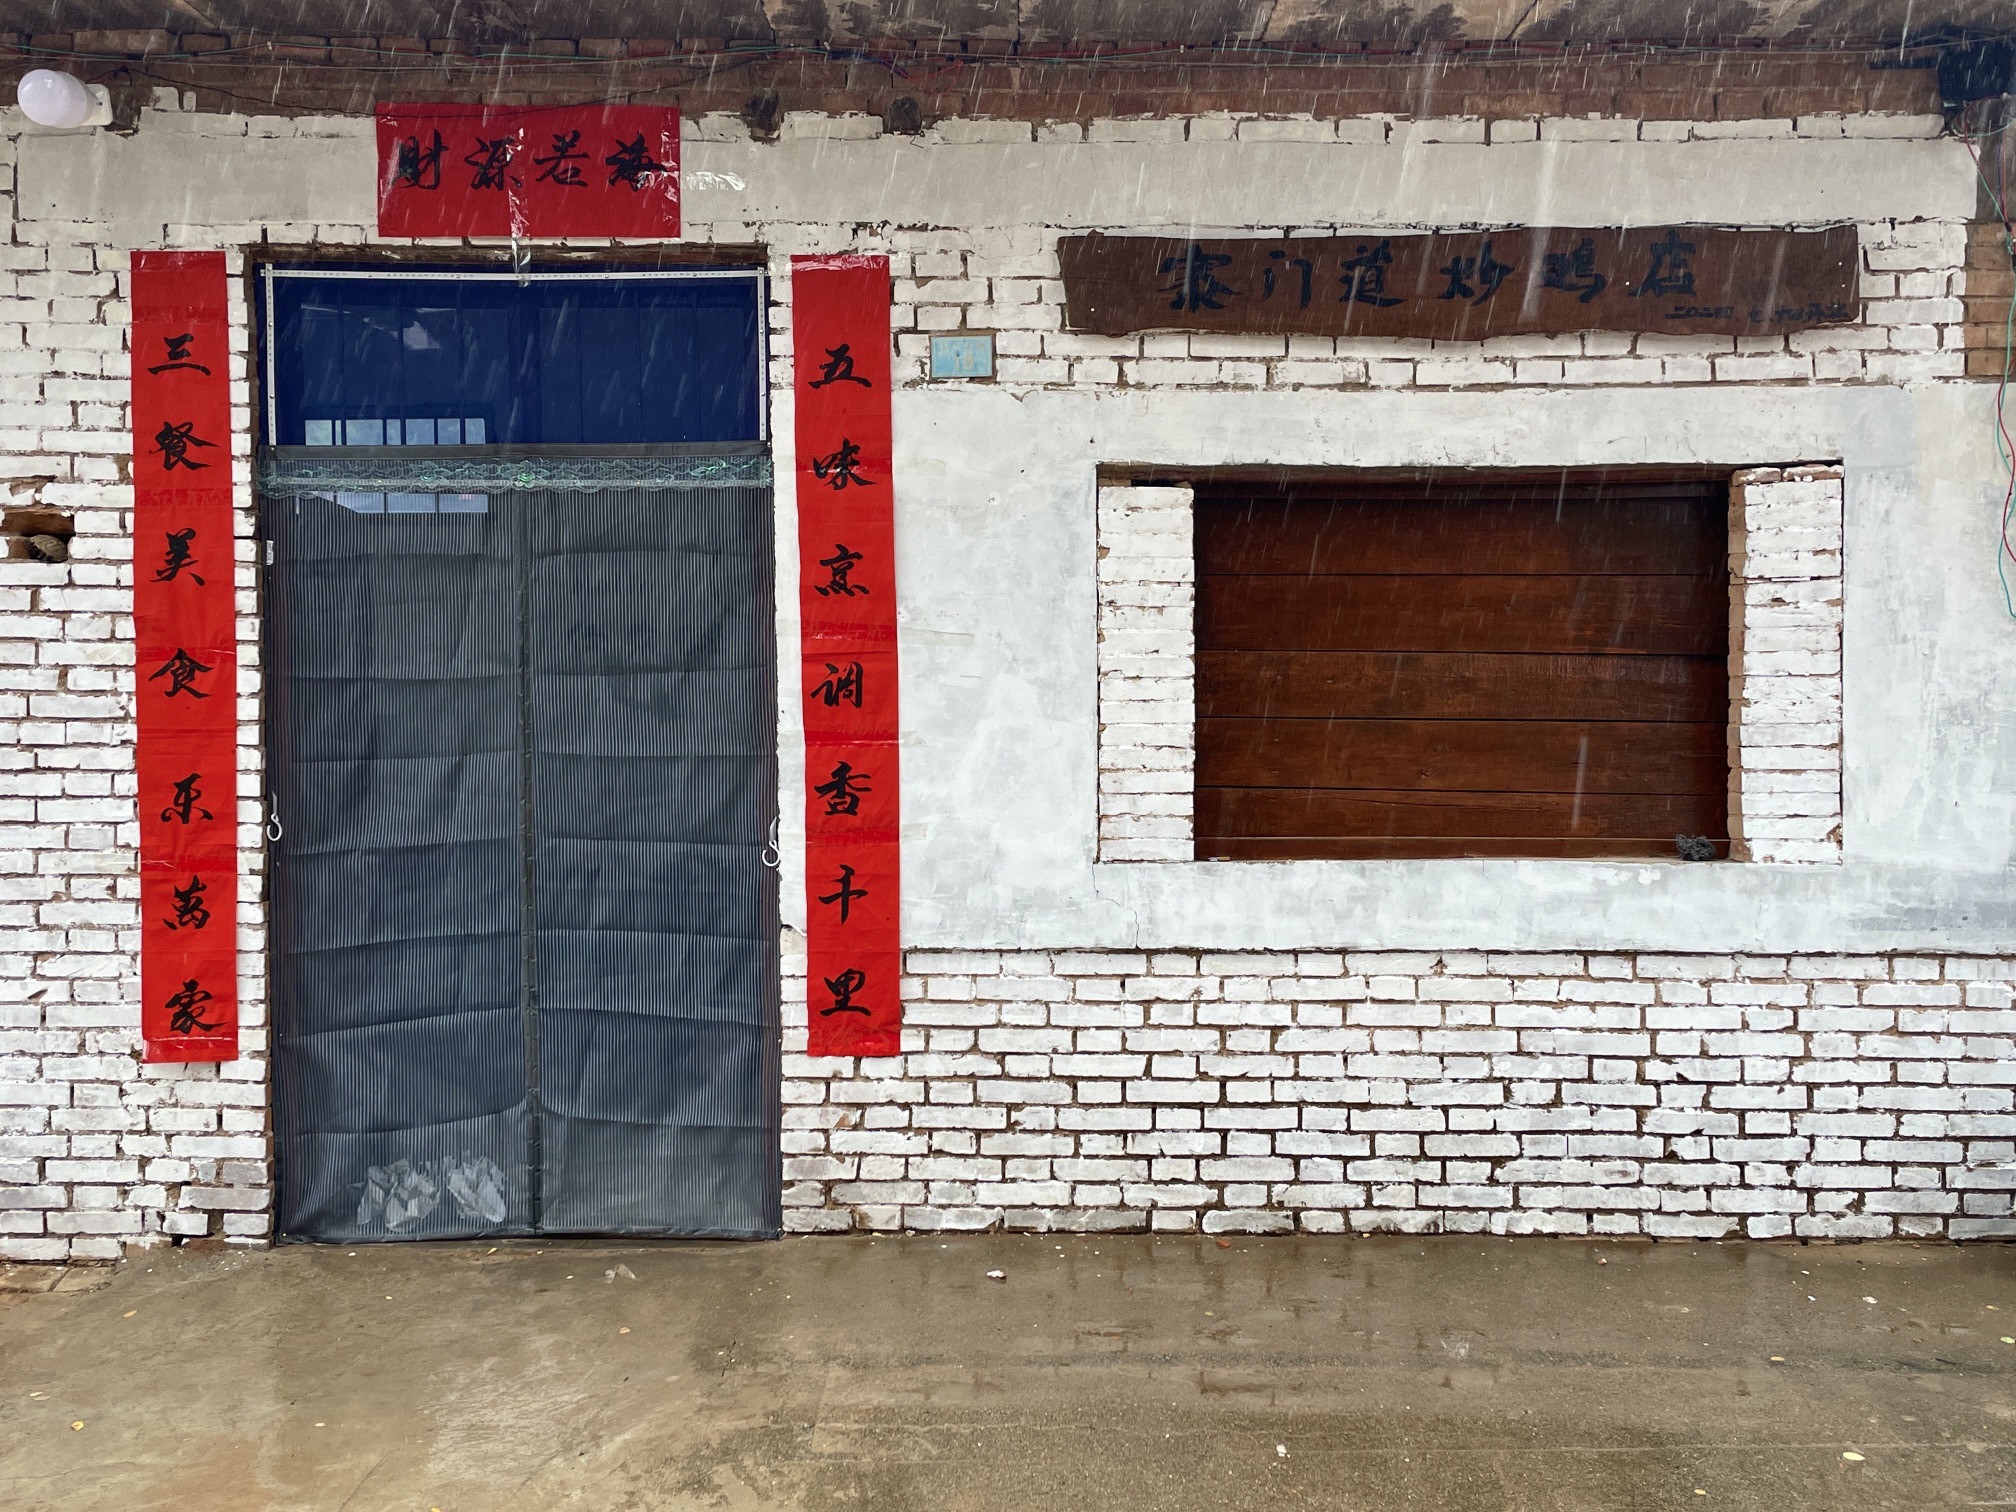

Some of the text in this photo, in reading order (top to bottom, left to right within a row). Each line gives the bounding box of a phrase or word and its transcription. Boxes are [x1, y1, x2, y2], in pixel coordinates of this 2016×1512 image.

[398, 129, 666, 191] 财源若海
[808, 343, 877, 1018] 五味烹调香千里
